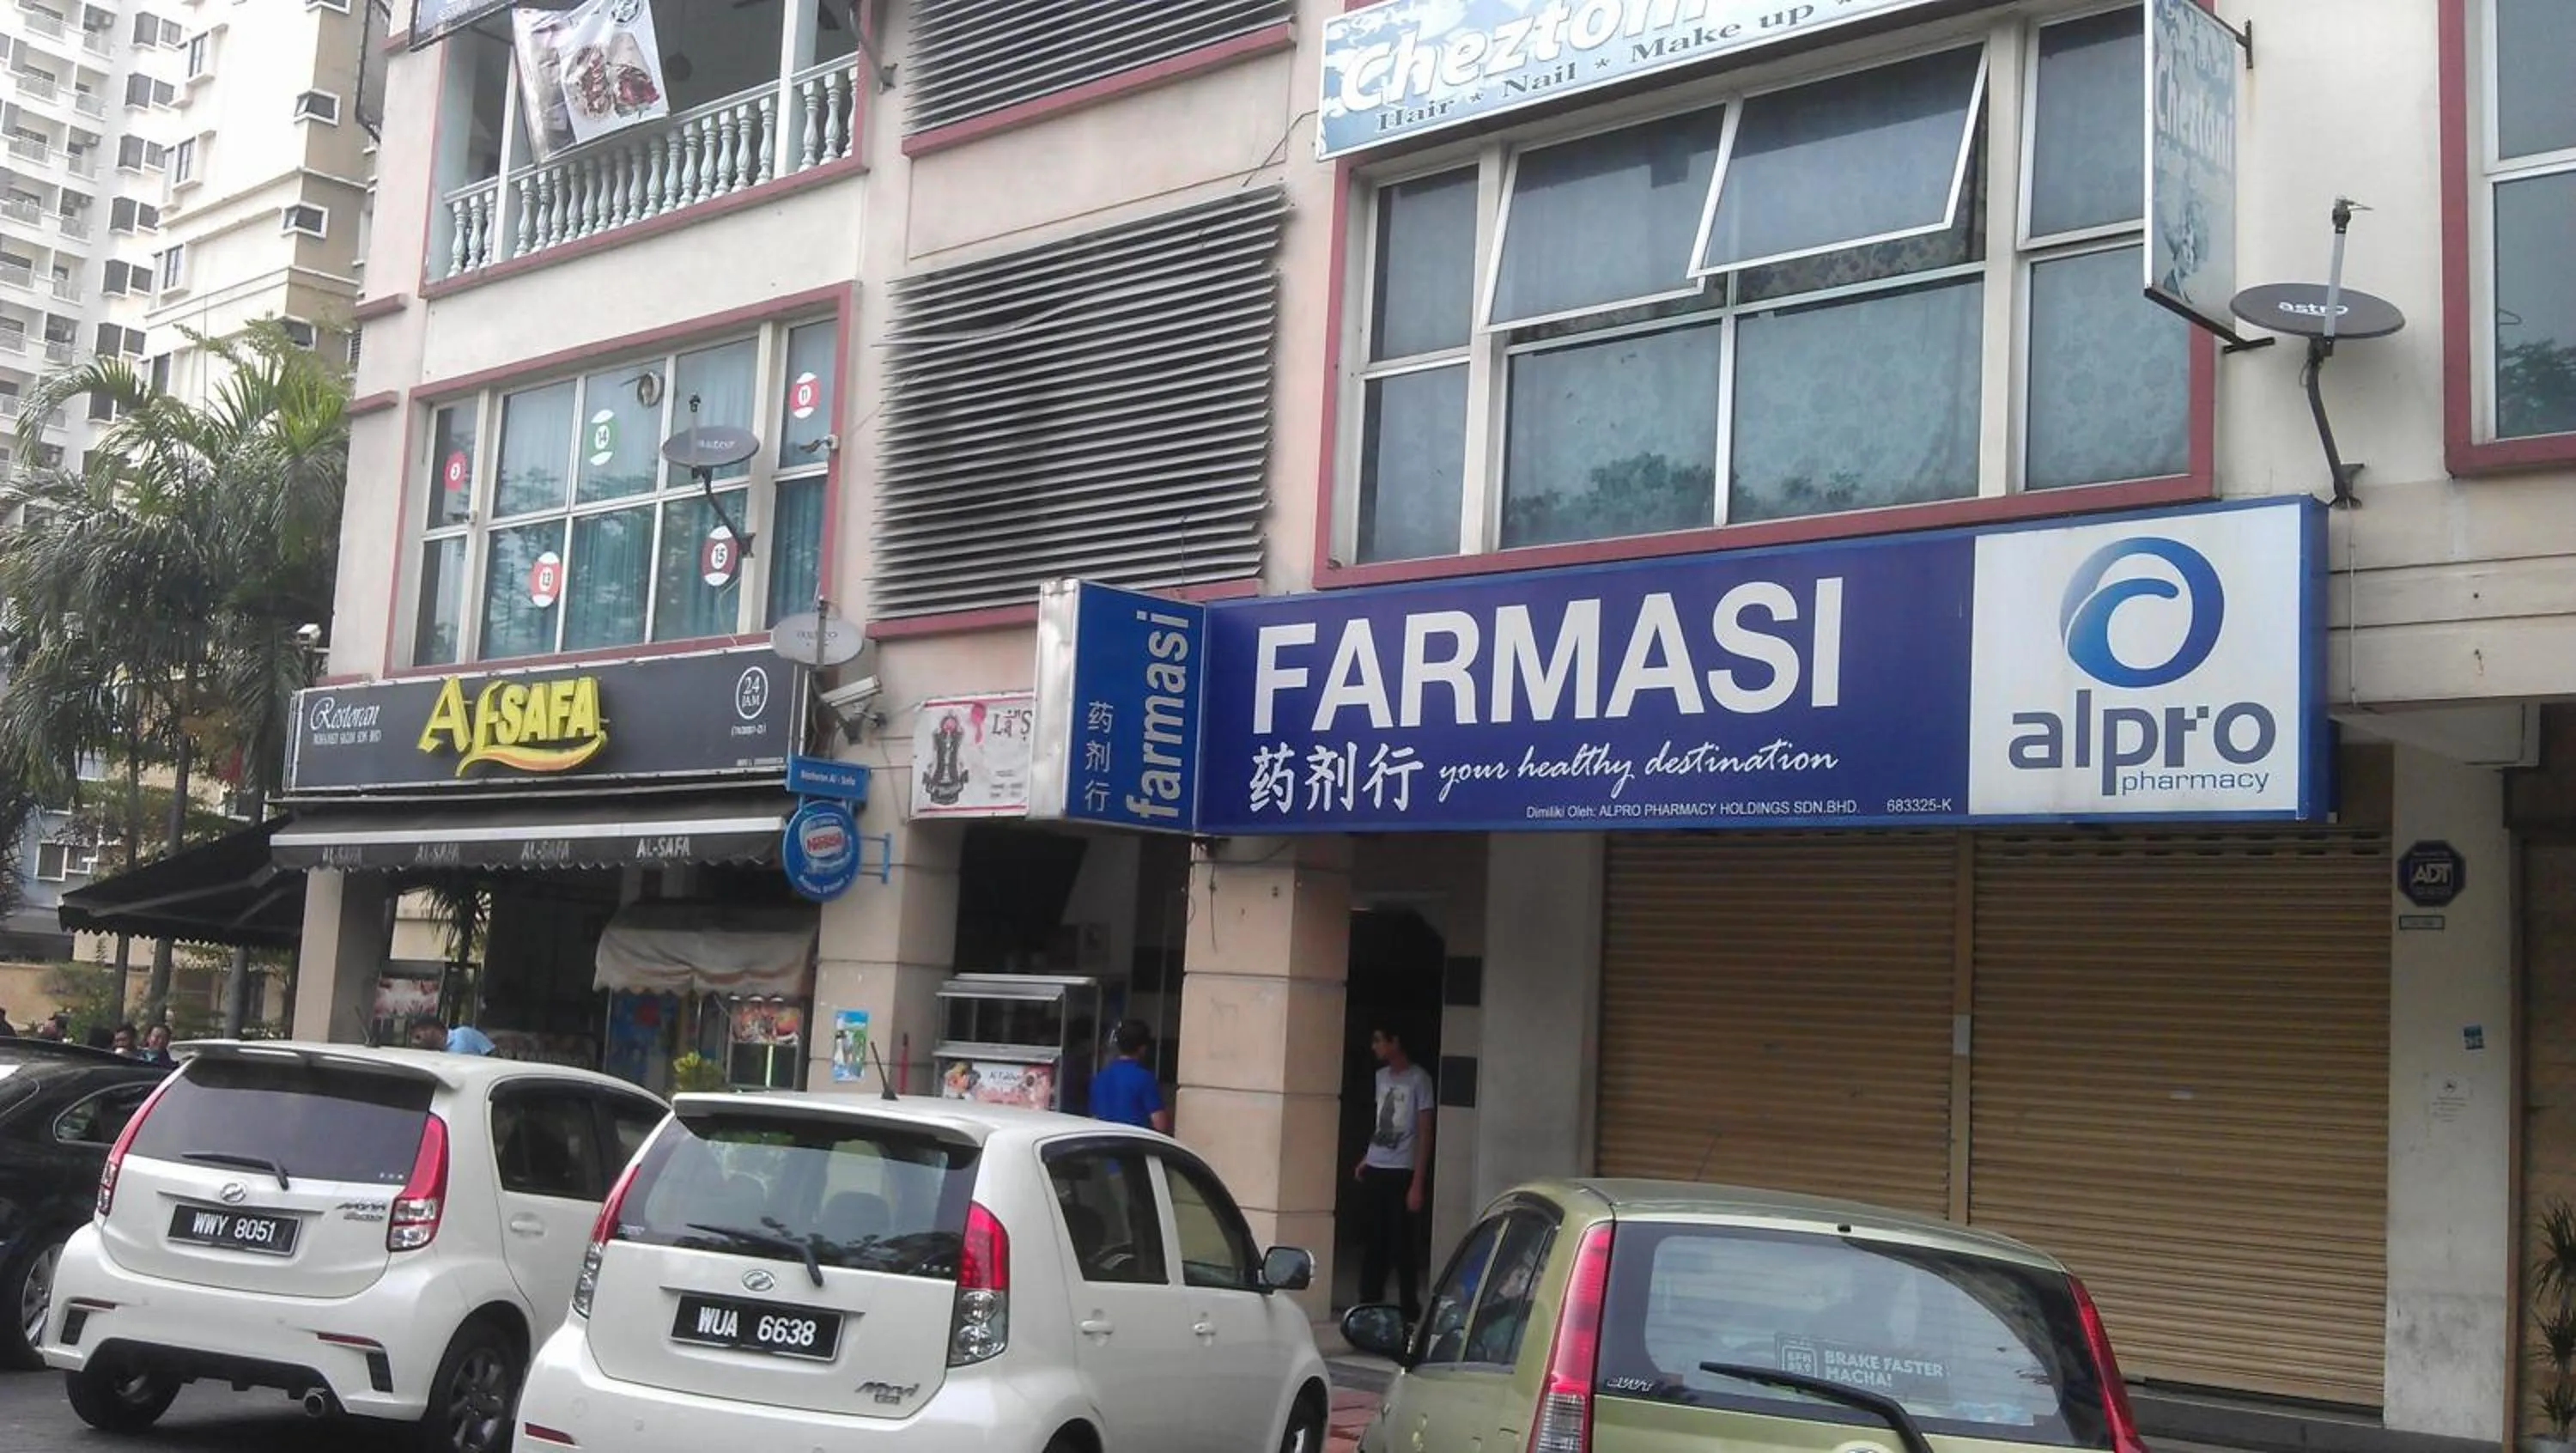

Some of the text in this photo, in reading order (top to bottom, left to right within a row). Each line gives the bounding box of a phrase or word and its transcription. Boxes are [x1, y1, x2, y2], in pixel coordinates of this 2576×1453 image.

[1376, 3, 1815, 132] Hair Nail Make up
[714, 546, 726, 566] 15
[1252, 576, 1844, 736] FARMASI
[743, 675, 761, 696] 24
[309, 696, 382, 732] Restoran
[1126, 610, 1190, 818] farmasi
[1084, 700, 1114, 812] 药剂行
[2008, 689, 2277, 796] alpro
[1249, 741, 1425, 814] 药剂行
[1438, 738, 1840, 800] your healthy destination
[2121, 771, 2270, 796] pharmacy
[1599, 803, 1642, 818] ALPRO
[1644, 801, 1717, 817] PHARMACY
[1720, 800, 1790, 815] HOLDINGS
[1886, 798, 1953, 812] 683325-K
[415, 842, 460, 862] AL-SAFA
[520, 839, 571, 860] AL-SAFA
[635, 836, 691, 859] AL-SAFA
[2412, 863, 2453, 884] ADT
[191, 1211, 276, 1243] WWY 8051
[696, 1305, 817, 1347] WUA 6638
[1824, 1349, 1944, 1377] BRAKE FASTER
[1825, 1366, 1894, 1389] MACHA!
